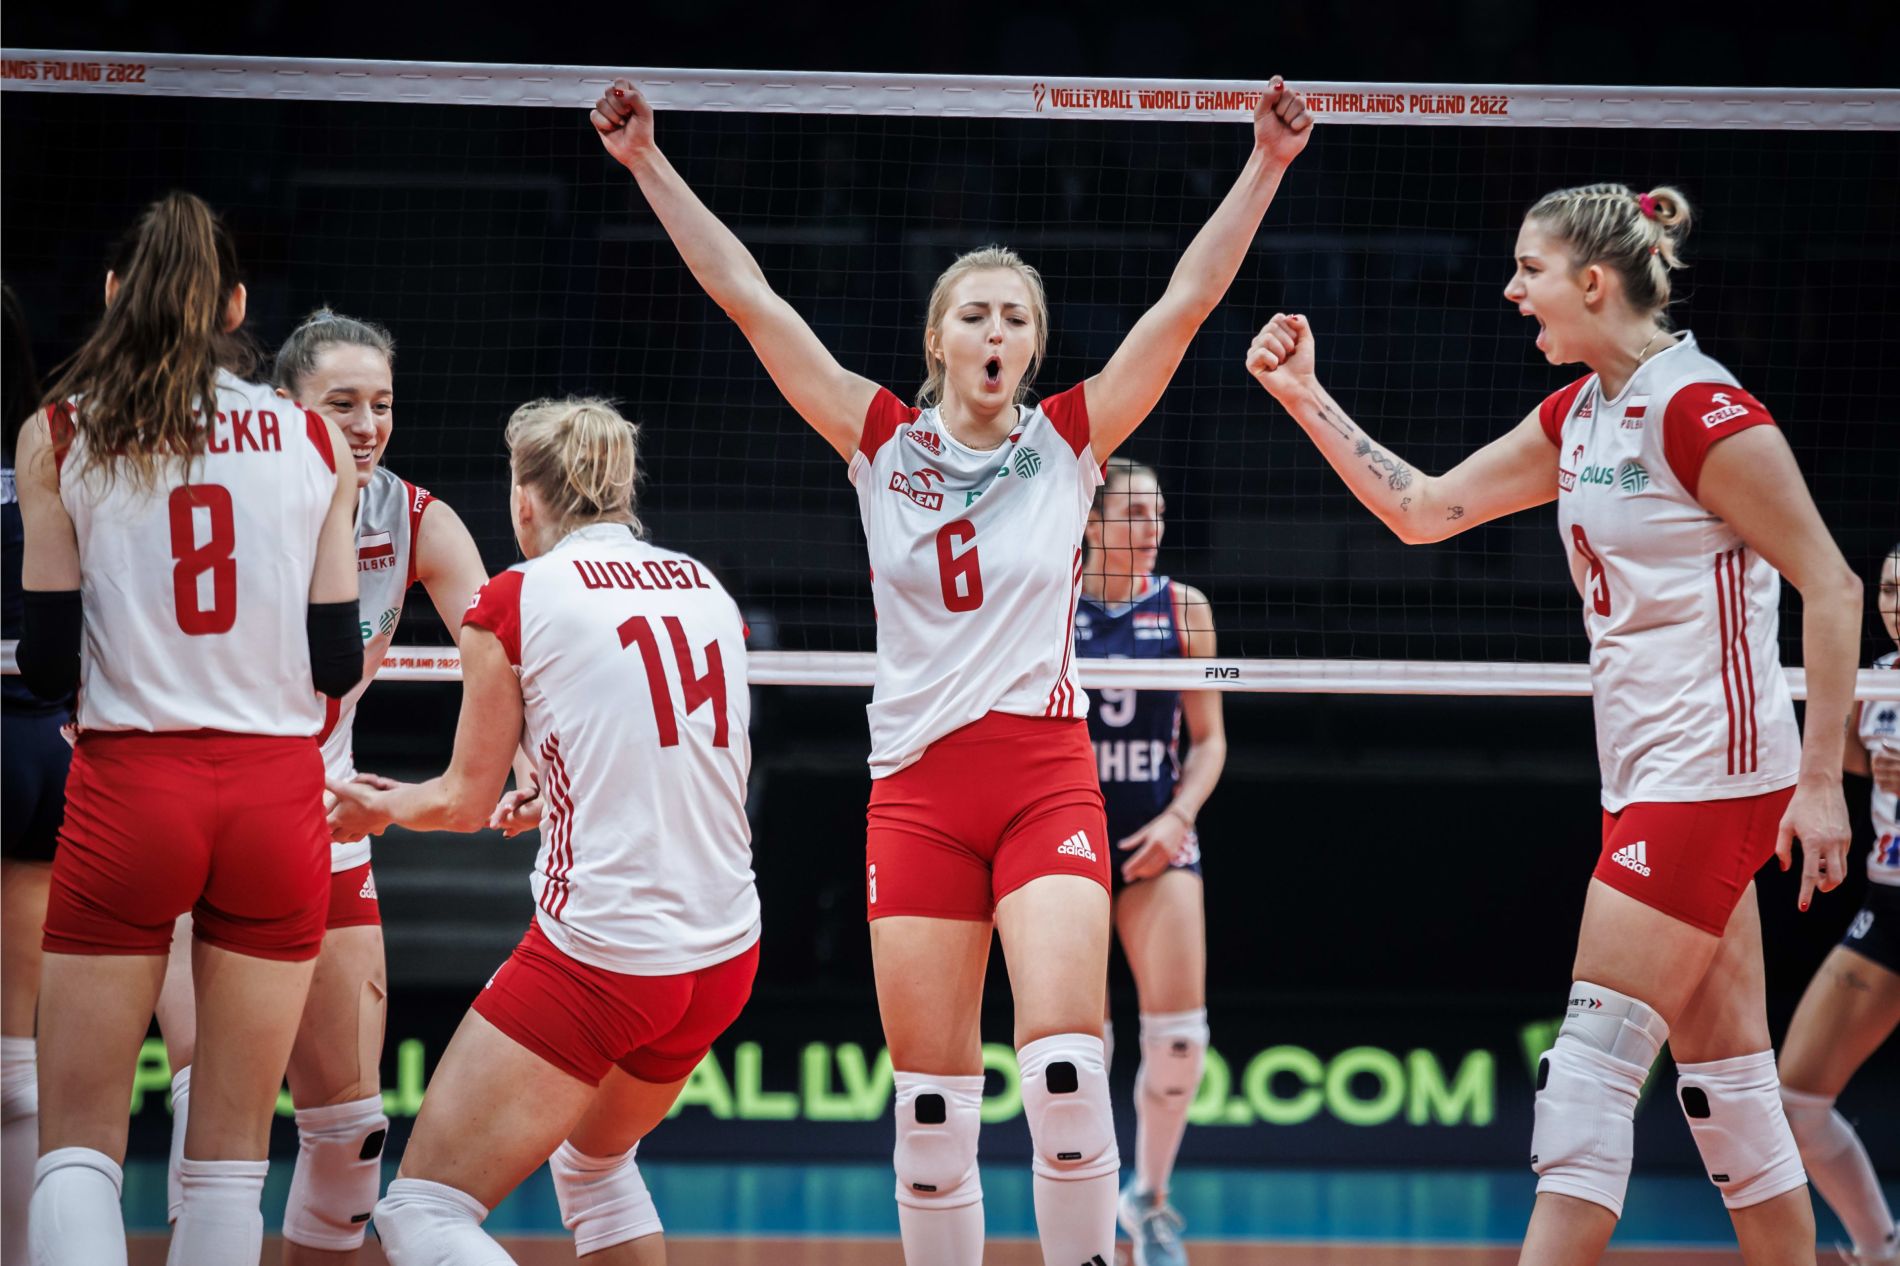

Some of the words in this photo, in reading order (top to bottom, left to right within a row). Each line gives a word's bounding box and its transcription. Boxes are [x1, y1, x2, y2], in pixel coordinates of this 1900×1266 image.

[43, 61, 100, 82] POLAND
[1051, 88, 1133, 109] VOLLEYBALL
[1139, 90, 1190, 110] WORLD
[1306, 93, 1405, 113] NETHERLANDS
[1409, 95, 1465, 114] POLAND
[1470, 96, 1509, 115] 2022
[906, 430, 941, 457] adidas
[893, 477, 940, 509] ORLEN
[168, 483, 237, 636] 8
[357, 556, 396, 572] OLSKA
[936, 518, 984, 613] 6
[1571, 523, 1612, 618] 9
[573, 559, 711, 591] WOŁOSZ
[616, 615, 730, 749] 14
[1205, 667, 1240, 679] FIVB
[1057, 845, 1097, 863] adidas
[1611, 851, 1651, 878] adidas
